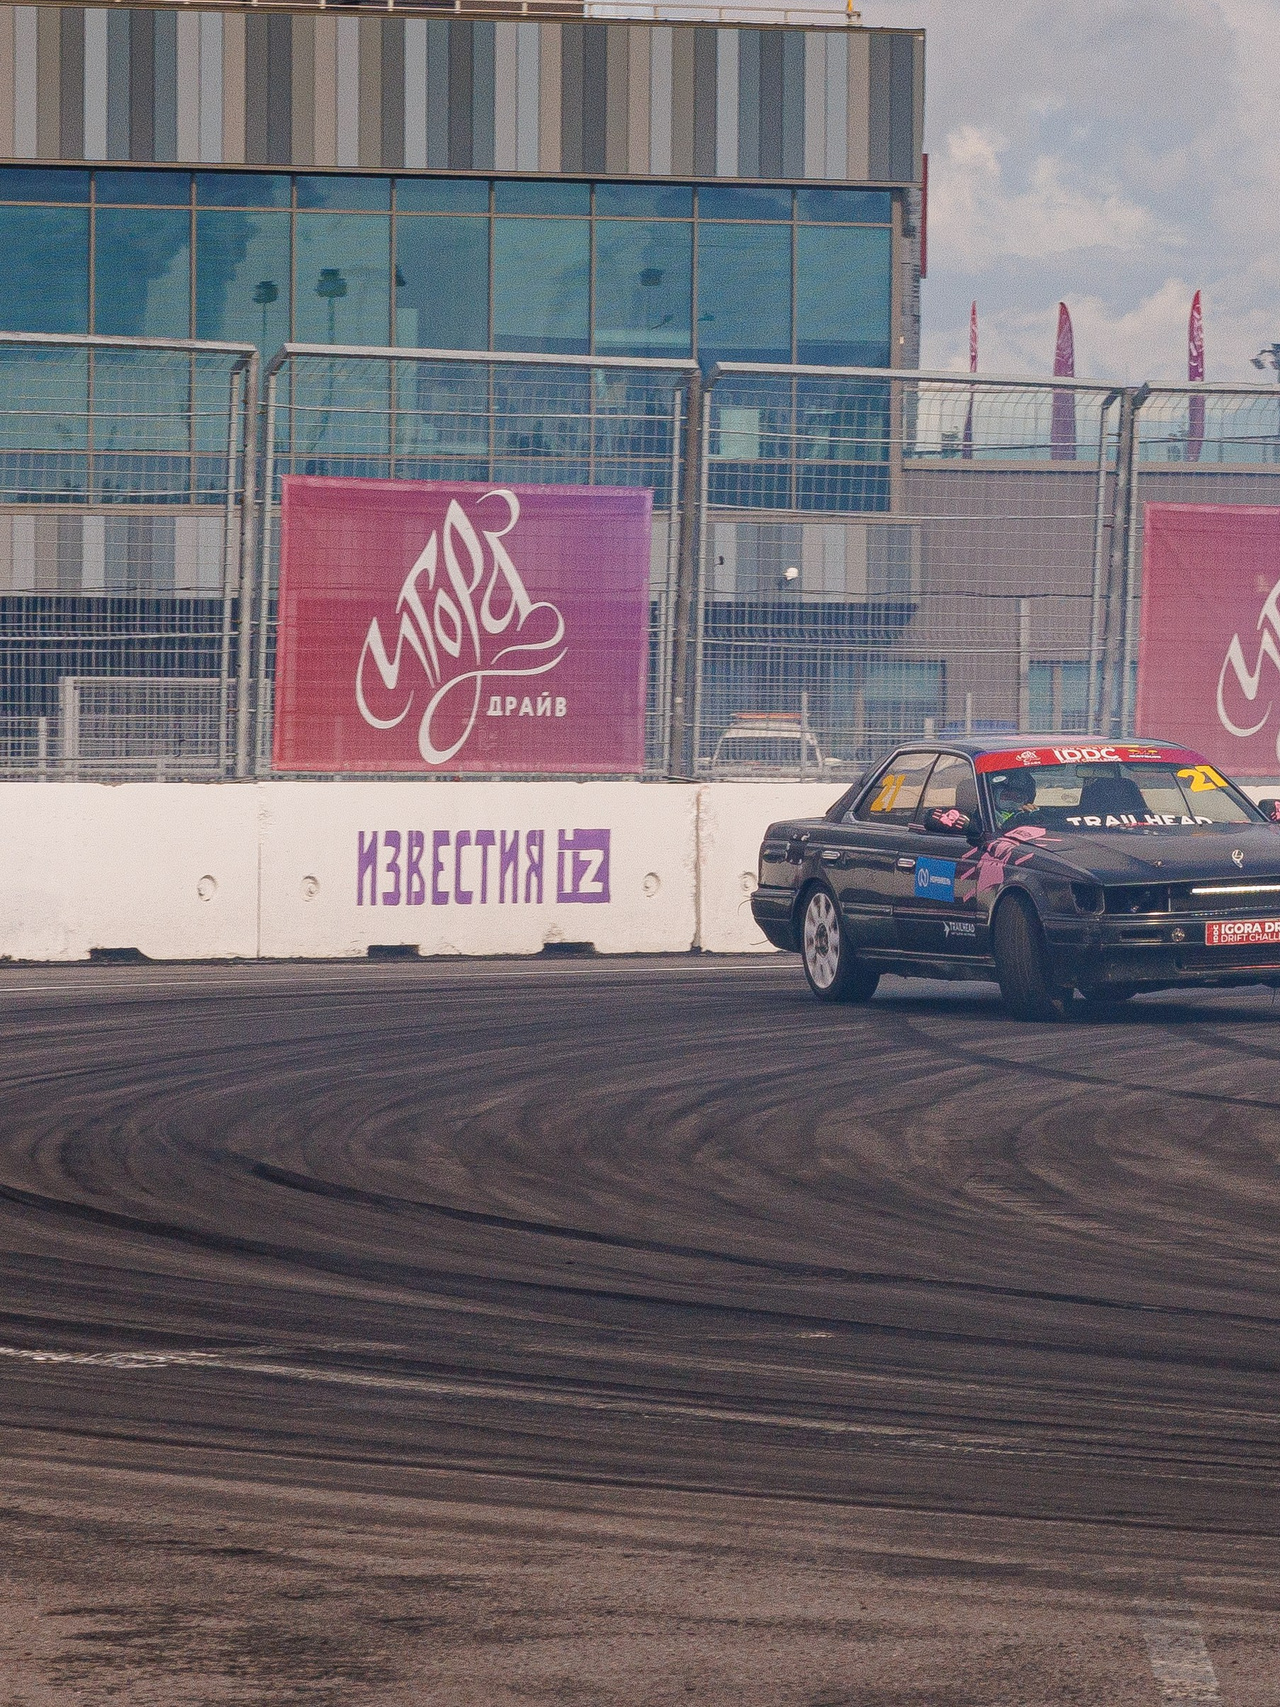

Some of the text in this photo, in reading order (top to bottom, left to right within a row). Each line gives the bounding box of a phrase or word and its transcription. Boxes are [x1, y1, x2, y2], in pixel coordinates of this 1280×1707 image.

[485, 691, 567, 717] ДРАЙВ
[1052, 748, 1119, 763] IDDC
[1176, 765, 1229, 792] 21
[870, 774, 906, 812] 21
[357, 829, 544, 906] ИЗВЕСТИЯ
[1220, 933, 1247, 943] DRIFT
[1221, 923, 1262, 934] IGORA
